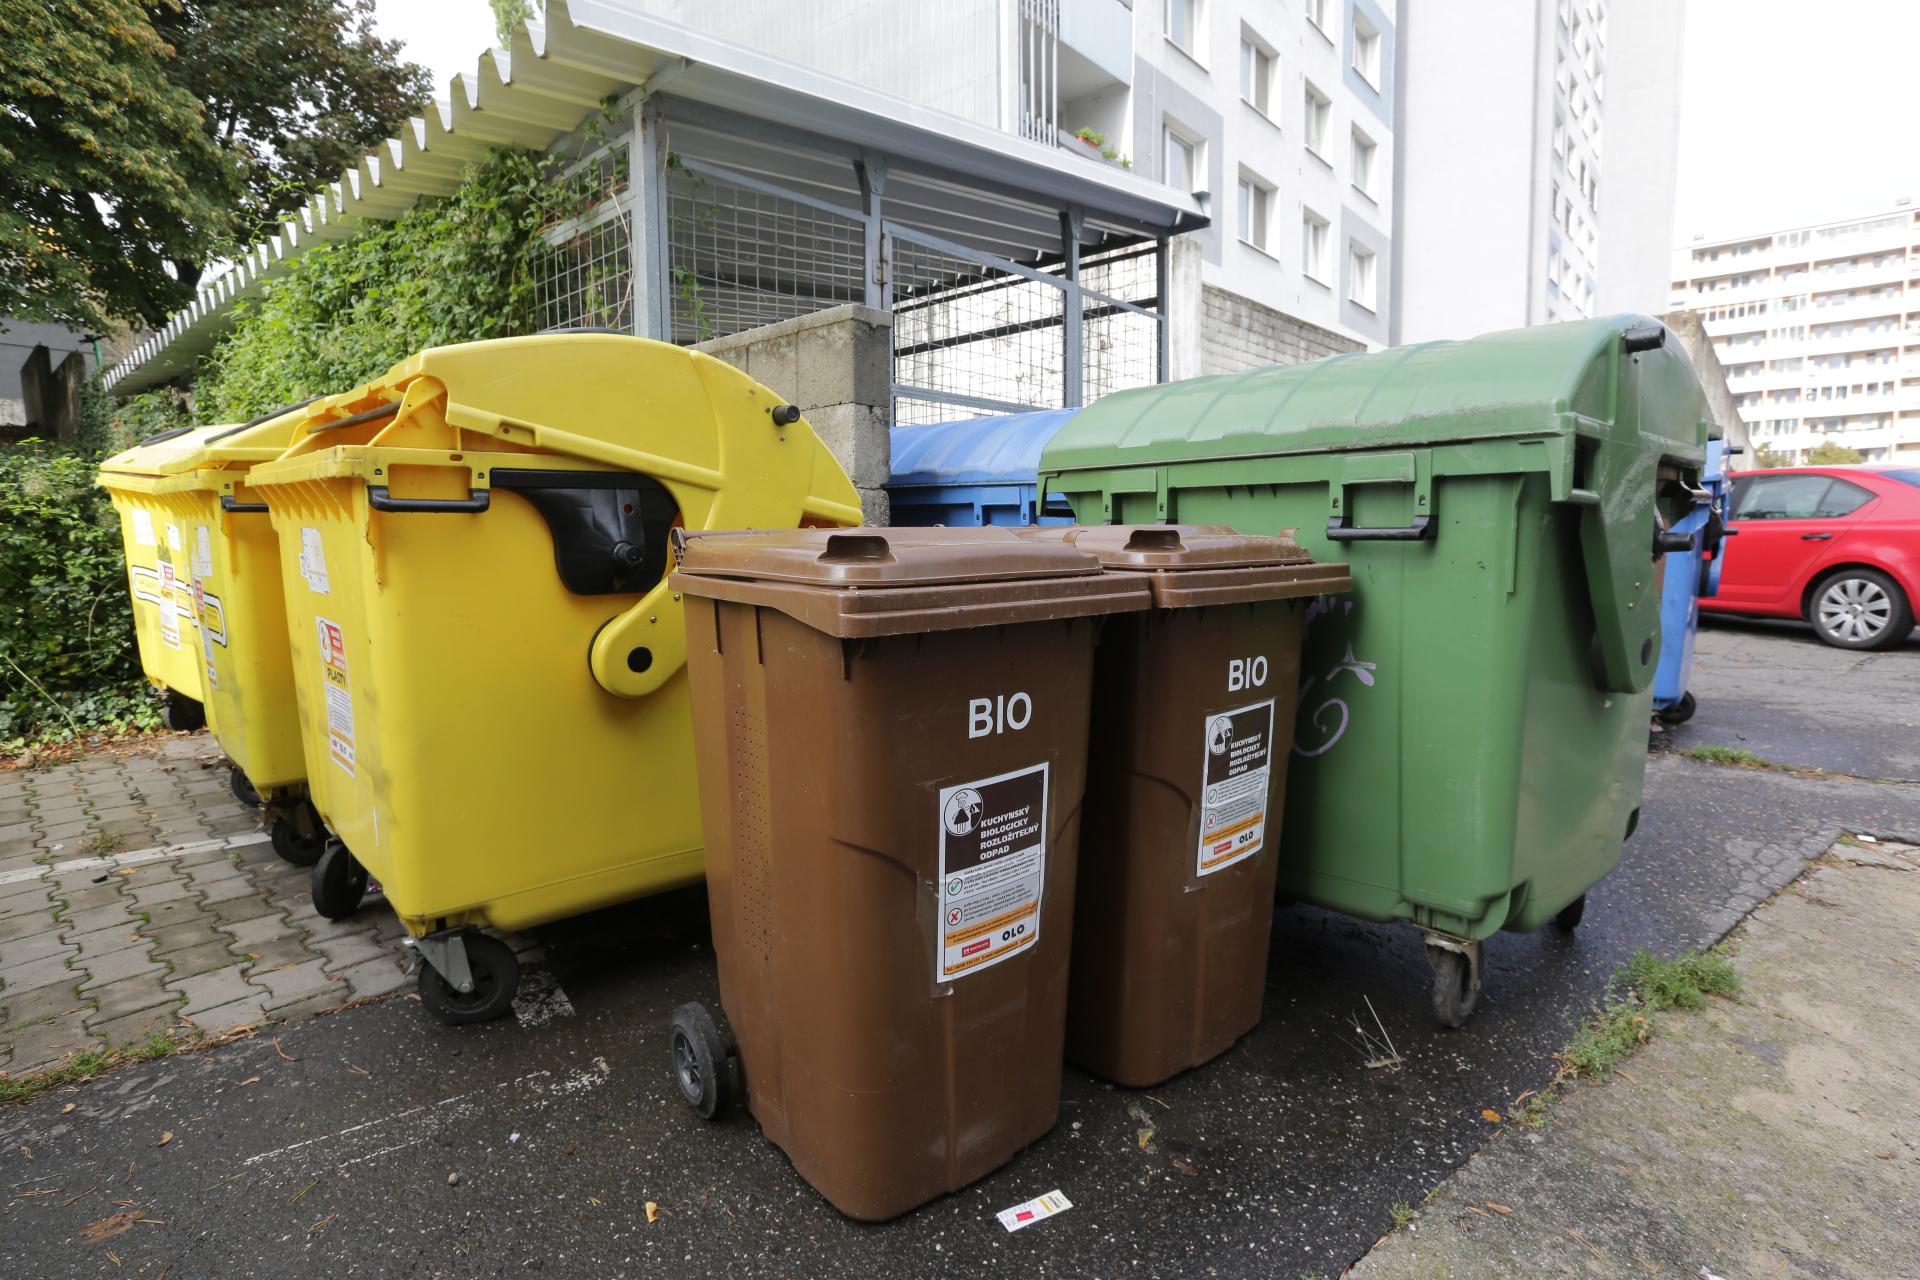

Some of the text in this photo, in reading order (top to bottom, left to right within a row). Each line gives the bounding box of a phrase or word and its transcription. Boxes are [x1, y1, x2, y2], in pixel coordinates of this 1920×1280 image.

[1228, 655, 1268, 692] BIO
[969, 692, 1032, 739] BIO
[1229, 764, 1248, 776] ODPAD
[980, 805, 1030, 828] KUCHYNSKÝ
[980, 817, 1029, 839] BIOLOGICKY
[1239, 831, 1254, 843] OLO
[980, 845, 1010, 860] ODPAD
[1002, 924, 1025, 941] OLO
